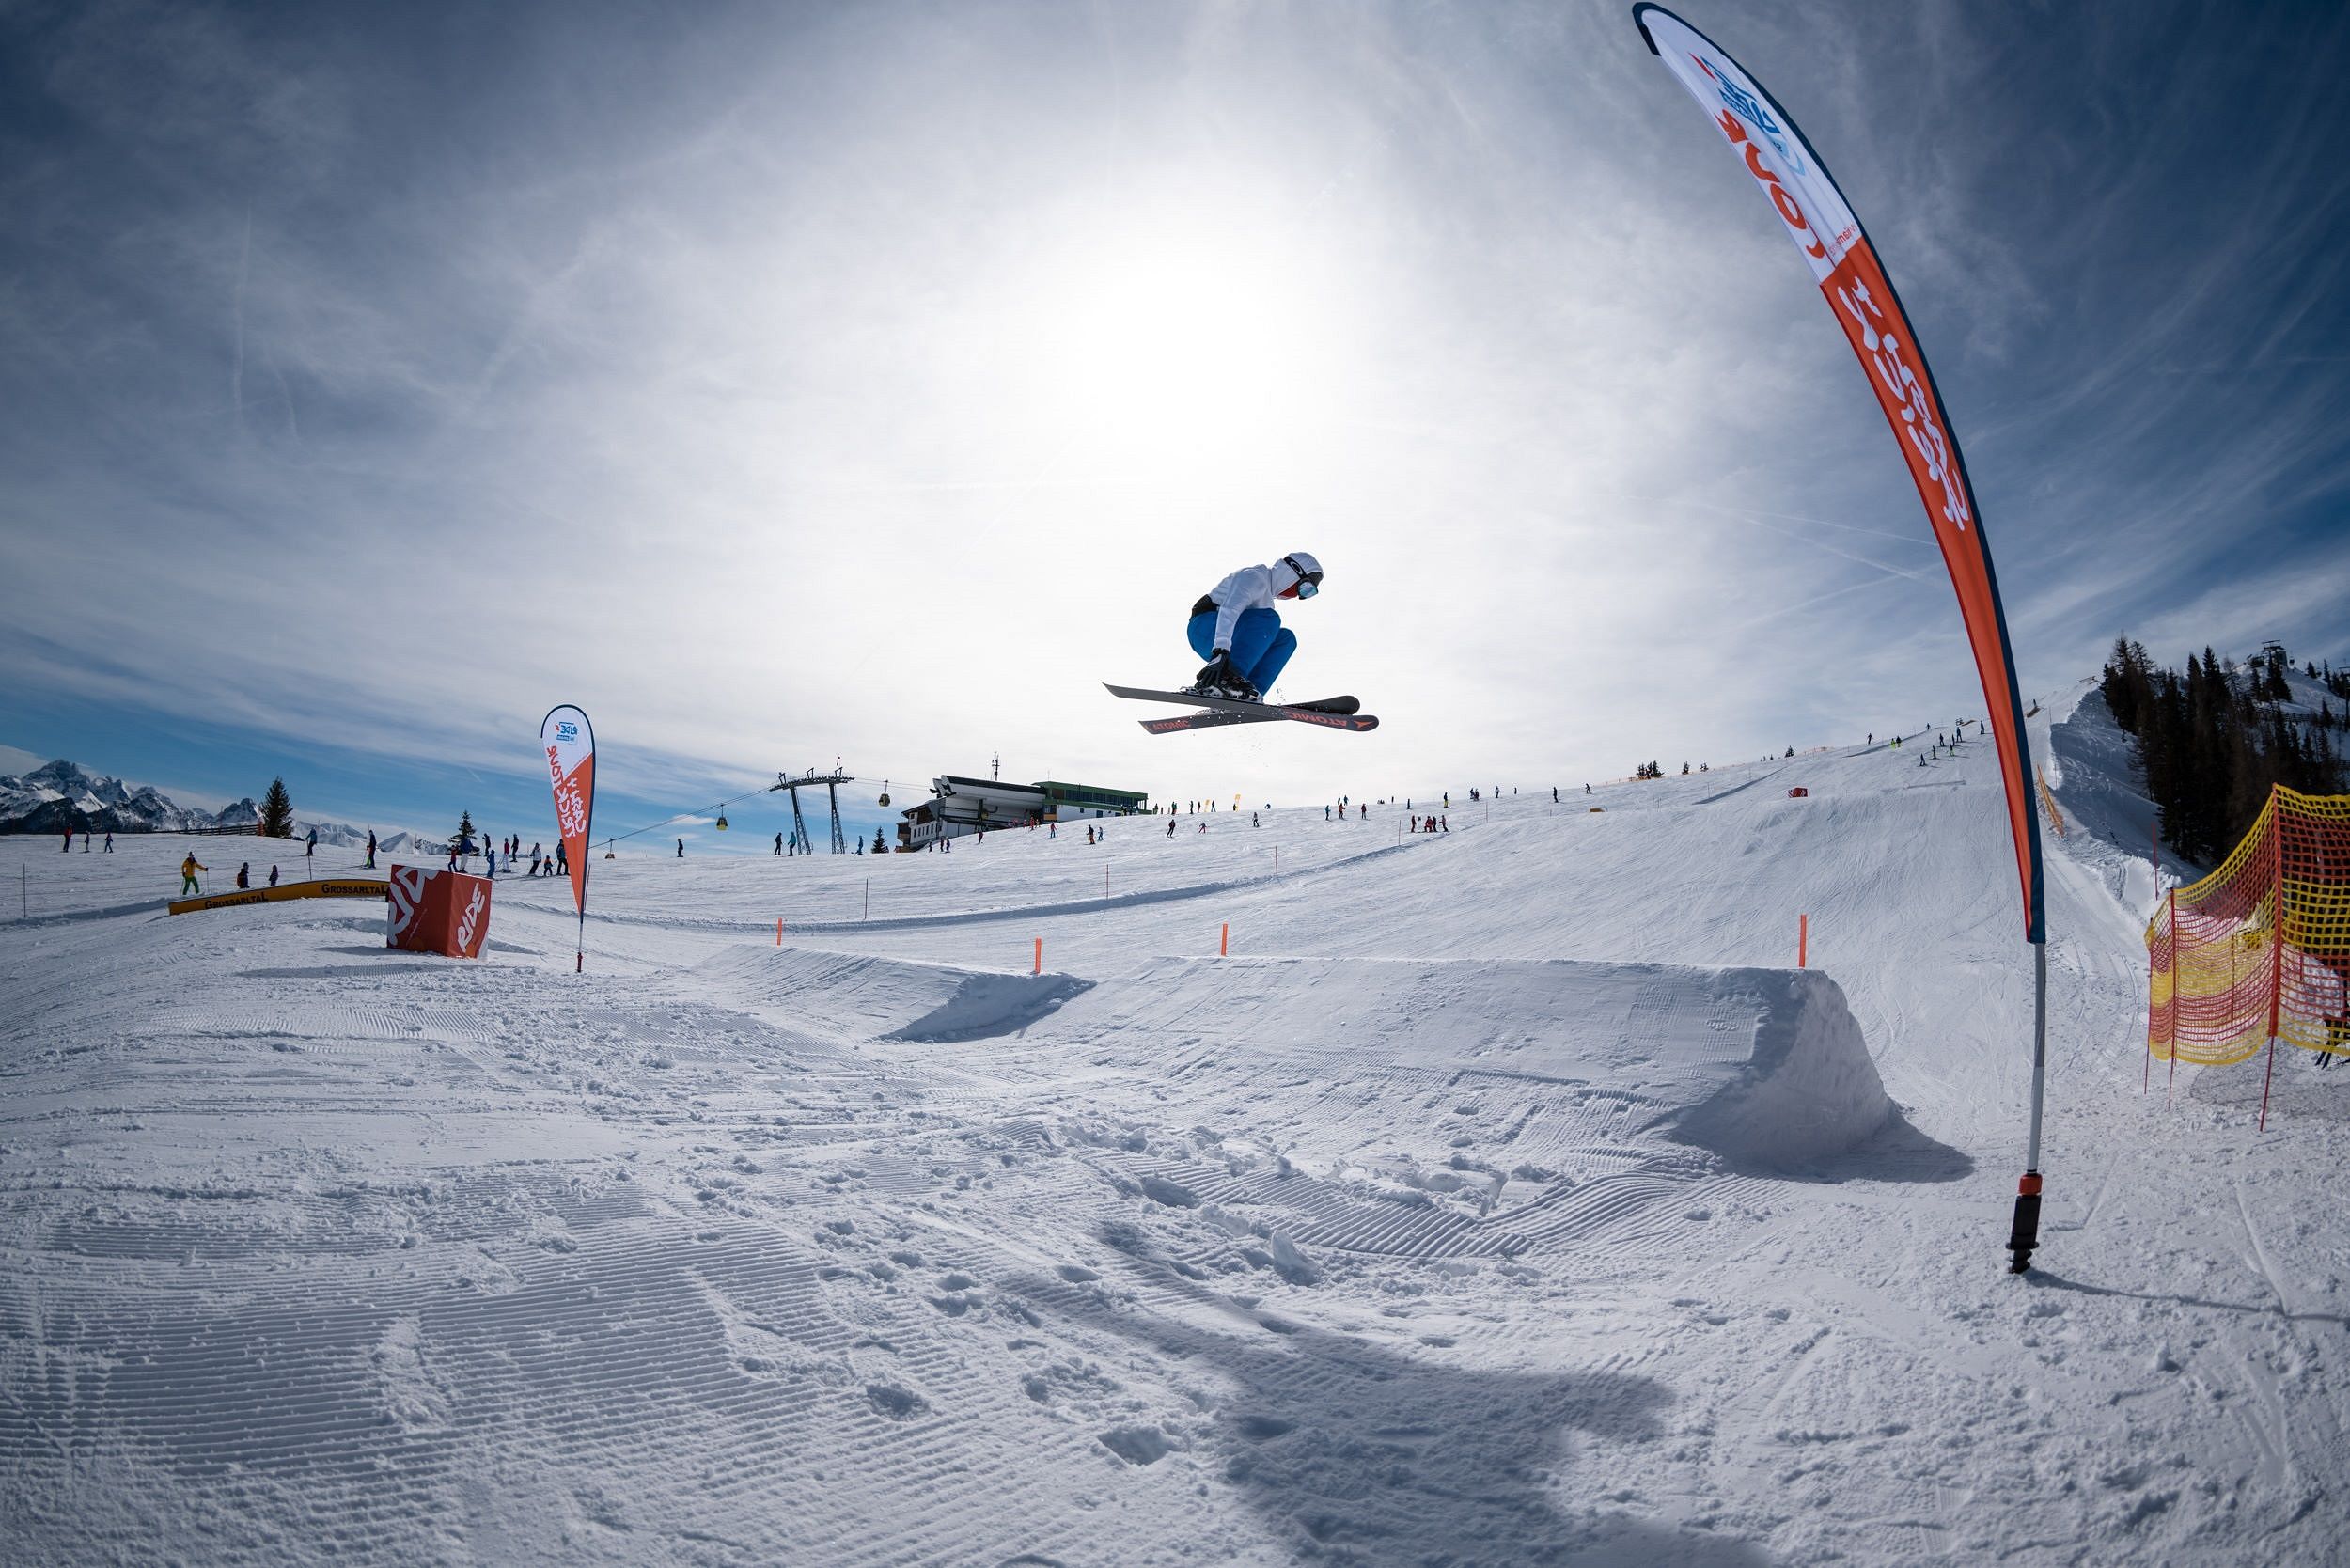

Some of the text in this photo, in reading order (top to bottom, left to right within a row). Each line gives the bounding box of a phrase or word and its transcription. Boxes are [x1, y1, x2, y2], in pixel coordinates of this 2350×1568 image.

[1153, 720, 1191, 731] ATOMIC
[1290, 712, 1347, 728] ATOMIC
[457, 882, 486, 953] RIDE
